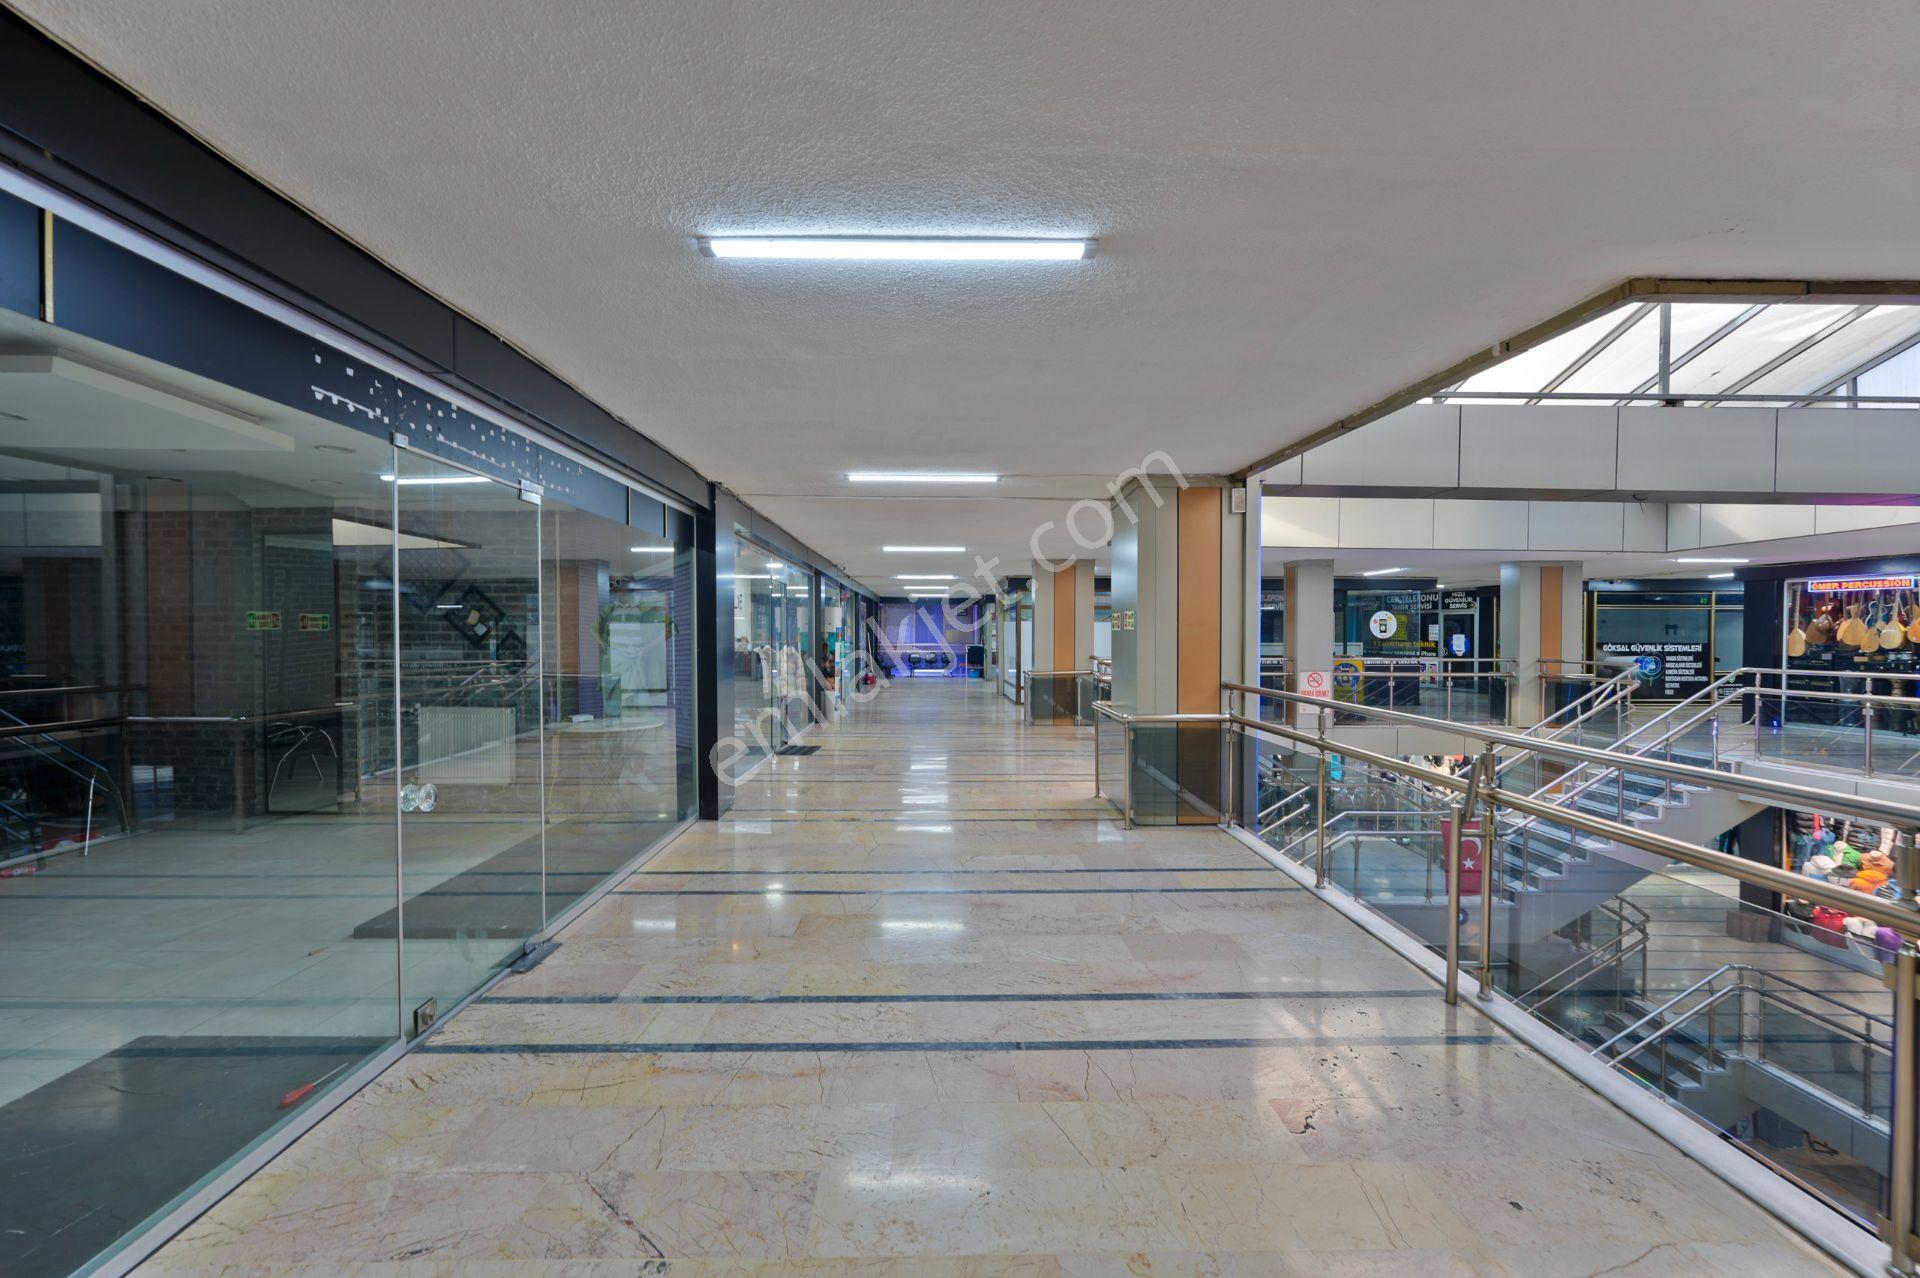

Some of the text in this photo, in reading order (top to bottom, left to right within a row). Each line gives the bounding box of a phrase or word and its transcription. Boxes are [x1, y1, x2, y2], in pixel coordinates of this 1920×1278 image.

[1812, 579, 1911, 590] ÖMER PERCUSSION
[1603, 643, 1702, 653] GÖKSAL GÜVENLİK SİSTEMLERİ
